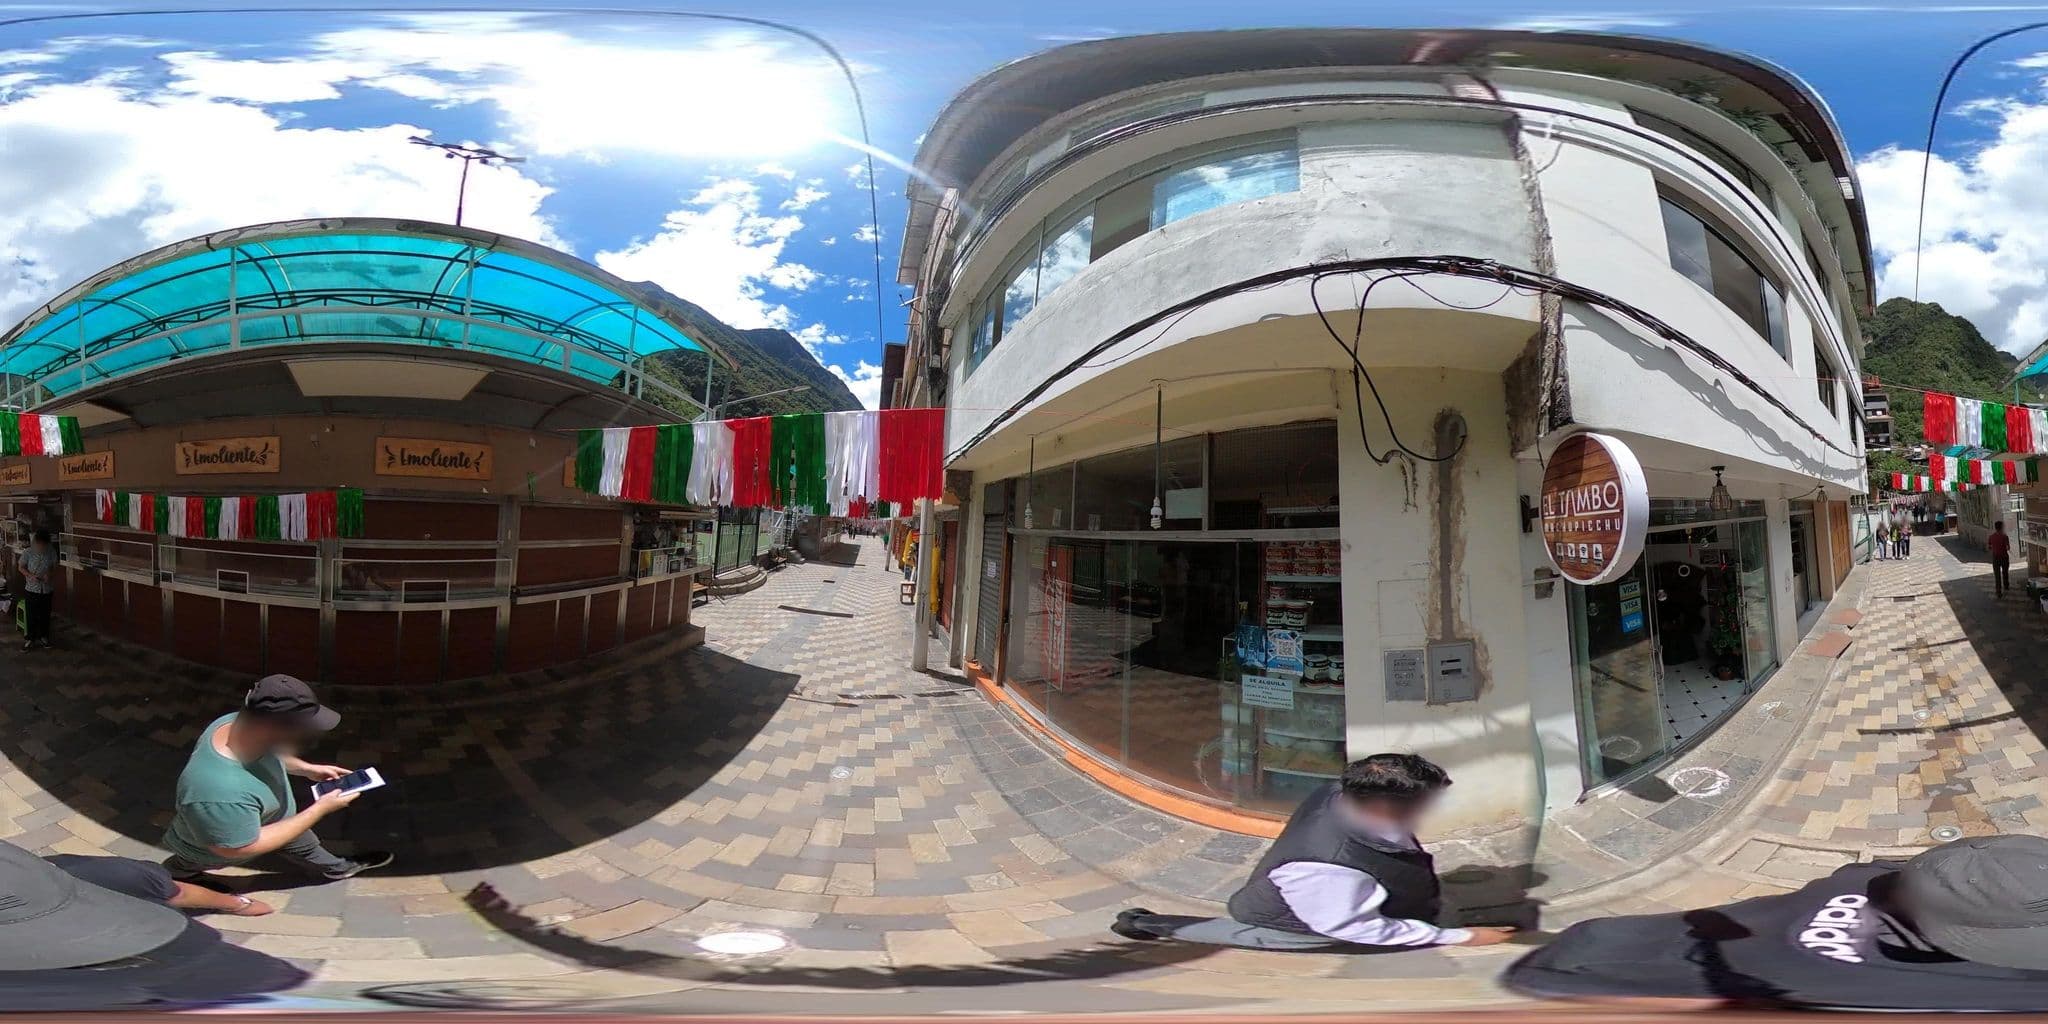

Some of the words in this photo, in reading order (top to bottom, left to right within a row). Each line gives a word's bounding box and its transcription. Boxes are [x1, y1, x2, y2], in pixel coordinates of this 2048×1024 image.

[194, 445, 257, 465] Emoliente
[400, 447, 471, 469] Emoliente
[1543, 494, 1555, 516] EL
[1558, 480, 1619, 517] TAMBO
[1622, 584, 1638, 594] VISA
[1624, 600, 1639, 610] VISA
[1626, 618, 1642, 629] VISA
